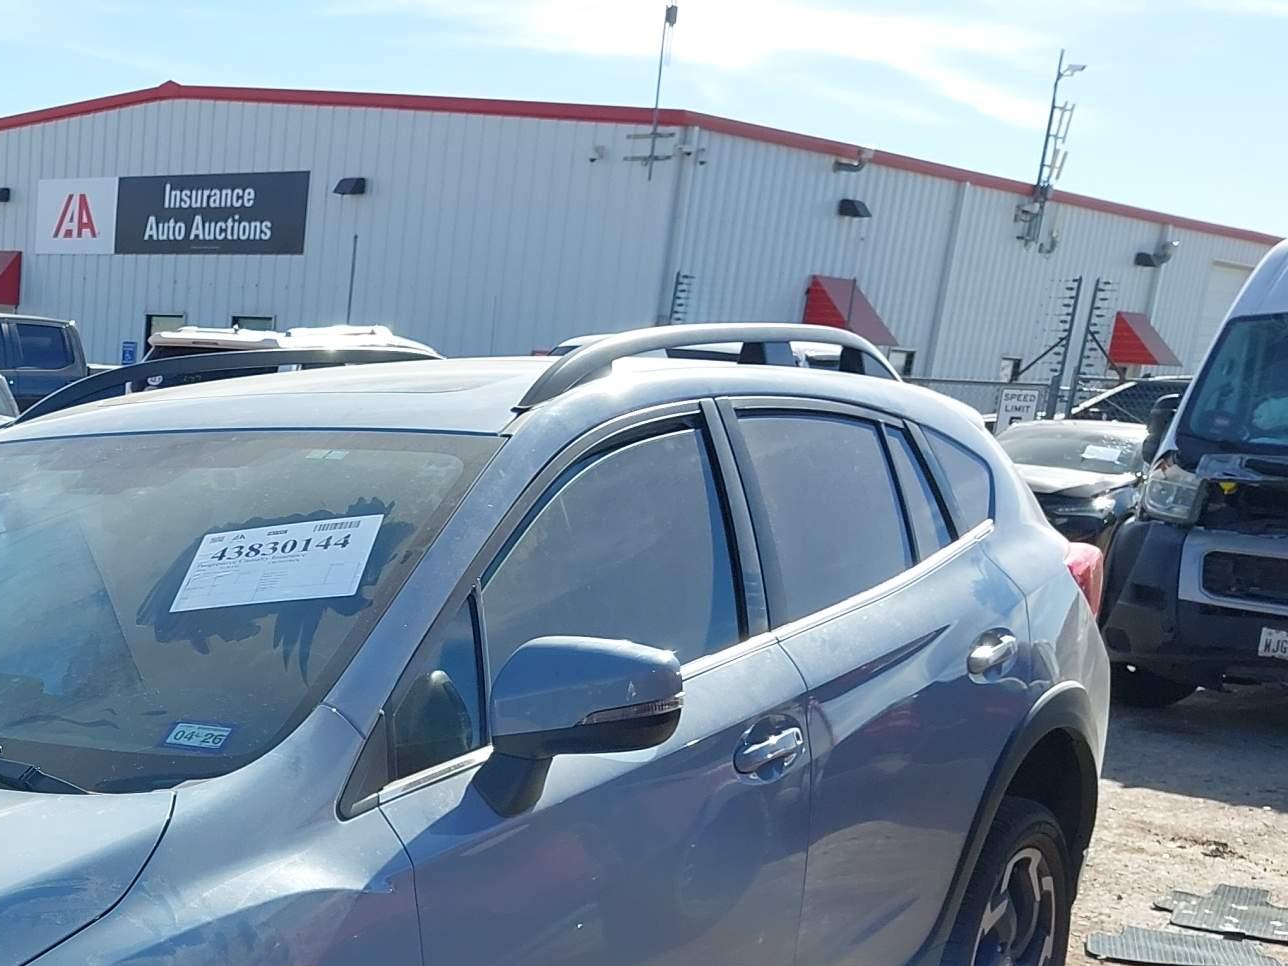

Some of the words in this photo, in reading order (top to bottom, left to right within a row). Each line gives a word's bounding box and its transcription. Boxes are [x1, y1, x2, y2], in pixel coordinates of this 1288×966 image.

[164, 183, 255, 209] Insurance
[143, 215, 186, 241] Auto
[189, 214, 272, 241] Auctions
[1004, 393, 1036, 402] SPEED
[1004, 404, 1031, 413] LIMIT
[211, 533, 351, 561] 43830144
